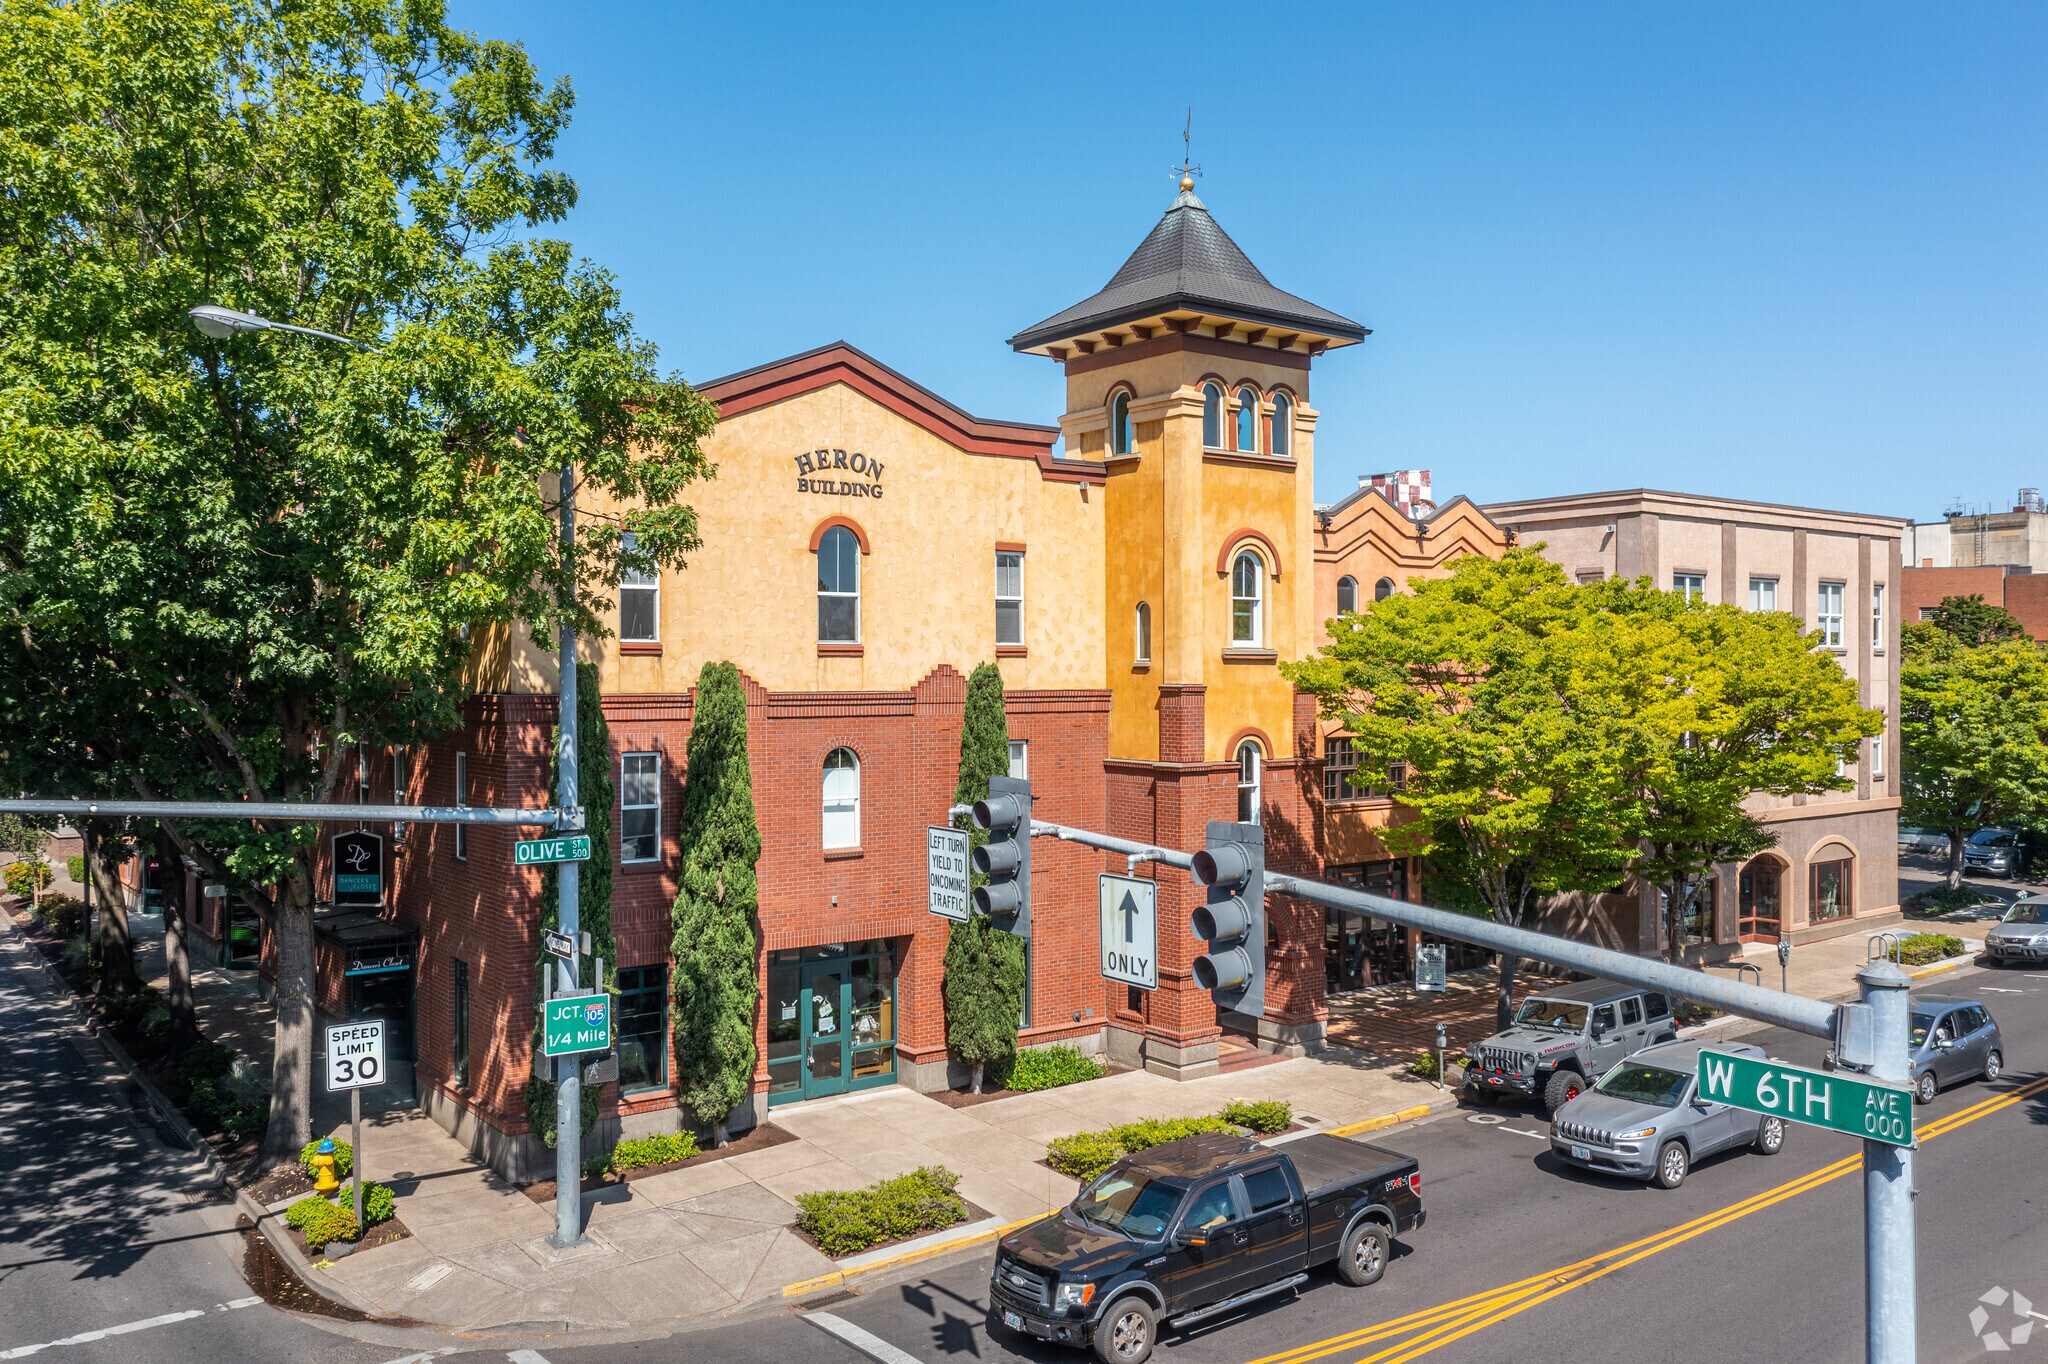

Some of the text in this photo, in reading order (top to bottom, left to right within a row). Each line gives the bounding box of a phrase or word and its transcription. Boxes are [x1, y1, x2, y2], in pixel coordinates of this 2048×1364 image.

[794, 448, 884, 482] HERON
[797, 478, 883, 498] BUILDING
[519, 840, 581, 861] OLIVE ST
[572, 848, 587, 858] 500
[930, 835, 965, 853] LEFT TURN
[932, 854, 963, 873] YIELD TO
[340, 876, 369, 884] DANCER'S
[930, 873, 966, 893] ONCOMING
[933, 892, 964, 912] TRAFFIC
[551, 937, 570, 952] ONE WAY
[382, 956, 403, 968] Closet
[1108, 951, 1149, 977] ONLY
[552, 1006, 583, 1020] JCT.
[587, 1009, 604, 1021] 105
[332, 1027, 379, 1042] SPEED
[548, 1029, 606, 1047] 1/4 Mile
[337, 1042, 374, 1056] LIMIT
[1544, 1042, 1576, 1054] RUBICON
[335, 1056, 378, 1082] 30
[1706, 1058, 1901, 1121] W 6TH AVE
[1864, 1111, 1906, 1140] 000
